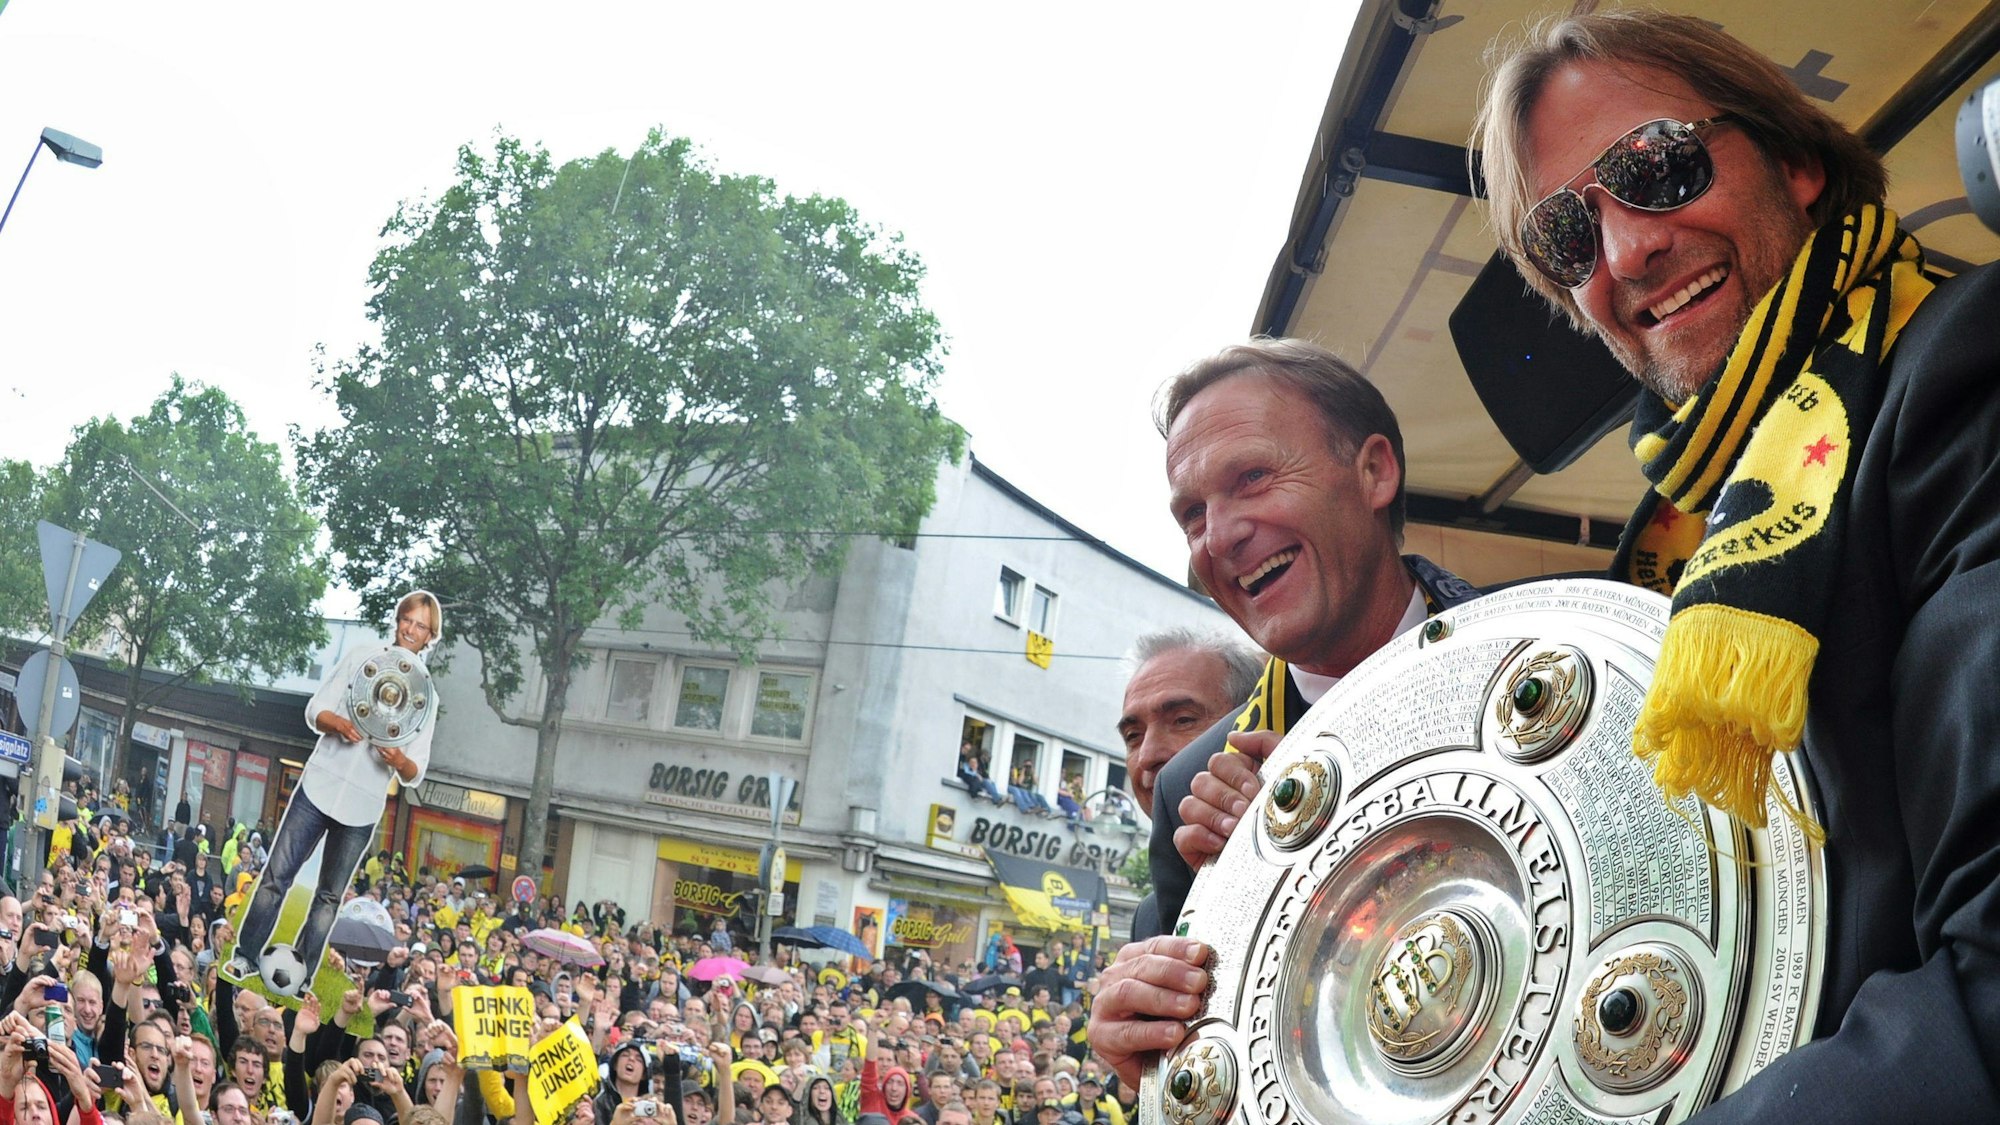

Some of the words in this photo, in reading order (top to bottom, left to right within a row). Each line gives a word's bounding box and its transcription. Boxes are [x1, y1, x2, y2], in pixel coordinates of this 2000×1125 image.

[1485, 592, 1513, 605] BAYERN
[1516, 586, 1554, 599] MÜNCHEN
[1582, 587, 1592, 595] FC
[1592, 588, 1623, 602] BAYERN
[1625, 595, 1663, 618] MÜNCHEN
[1516, 600, 1552, 610] MÜNCHEN
[1571, 600, 1580, 609] FC
[1582, 601, 1610, 615] BAYERN
[1614, 606, 1650, 629] MÜNCHEN
[1611, 676, 1639, 702] LEIPZIG
[1603, 702, 1630, 732] BAYERN
[1576, 747, 1592, 764] TSV
[650, 762, 729, 799] BORSIG
[1561, 767, 1574, 784] 1975
[1600, 716, 1628, 751] SCHALKE
[1634, 766, 1647, 788] 1943
[1644, 786, 1666, 846] DRESDNER
[1774, 762, 1791, 788] 1988
[1546, 773, 1572, 802] DBACH
[1572, 808, 1585, 830] 1978
[1572, 782, 1599, 830] BORUSSIA
[1767, 801, 1779, 816] FC
[1585, 736, 1626, 797] FRANKFURT/M
[1622, 801, 1636, 824] 1960
[1636, 852, 1650, 914] HAMBURG
[1594, 728, 1609, 746] 1953
[1611, 752, 1623, 766] FC
[1619, 763, 1657, 862] KAISERSLAUTERN
[1650, 881, 1660, 910] 1954
[971, 817, 1062, 861] BORSIG
[1569, 757, 1601, 806] GLADBACH
[1600, 812, 1613, 833] 1971
[1607, 835, 1624, 895] BORUSSIA
[1616, 896, 1626, 922] VFL
[1594, 830, 1608, 851] VFL
[1619, 833, 1632, 859] 1860
[1662, 807, 1679, 863] FORTUNA
[1770, 817, 1786, 864] BAYERN
[1790, 820, 1805, 866] ERDER
[1600, 856, 1610, 880] 1900
[1684, 856, 1694, 880] 1924
[1686, 794, 1698, 814] 908
[1699, 878, 1710, 922] BERLIN
[674, 880, 721, 904] BORSIG
[1625, 866, 1636, 890] 1967
[1628, 892, 1638, 916] BRA
[1777, 868, 1788, 936] MÜNCHEN
[1796, 870, 1807, 925] BREMEN
[894, 917, 932, 940] BORSIG
[932, 922, 972, 944] Grill
[1604, 914, 1614, 926] M
[1774, 948, 1786, 980] 2004
[1792, 951, 1804, 980] 1989
[1770, 984, 1782, 1002] SV
[1788, 986, 1800, 1001] FC
[1754, 1008, 1778, 1068] WERDER
[541, 1053, 587, 1100] JUNGS!
[1534, 1084, 1551, 1110] 1979
